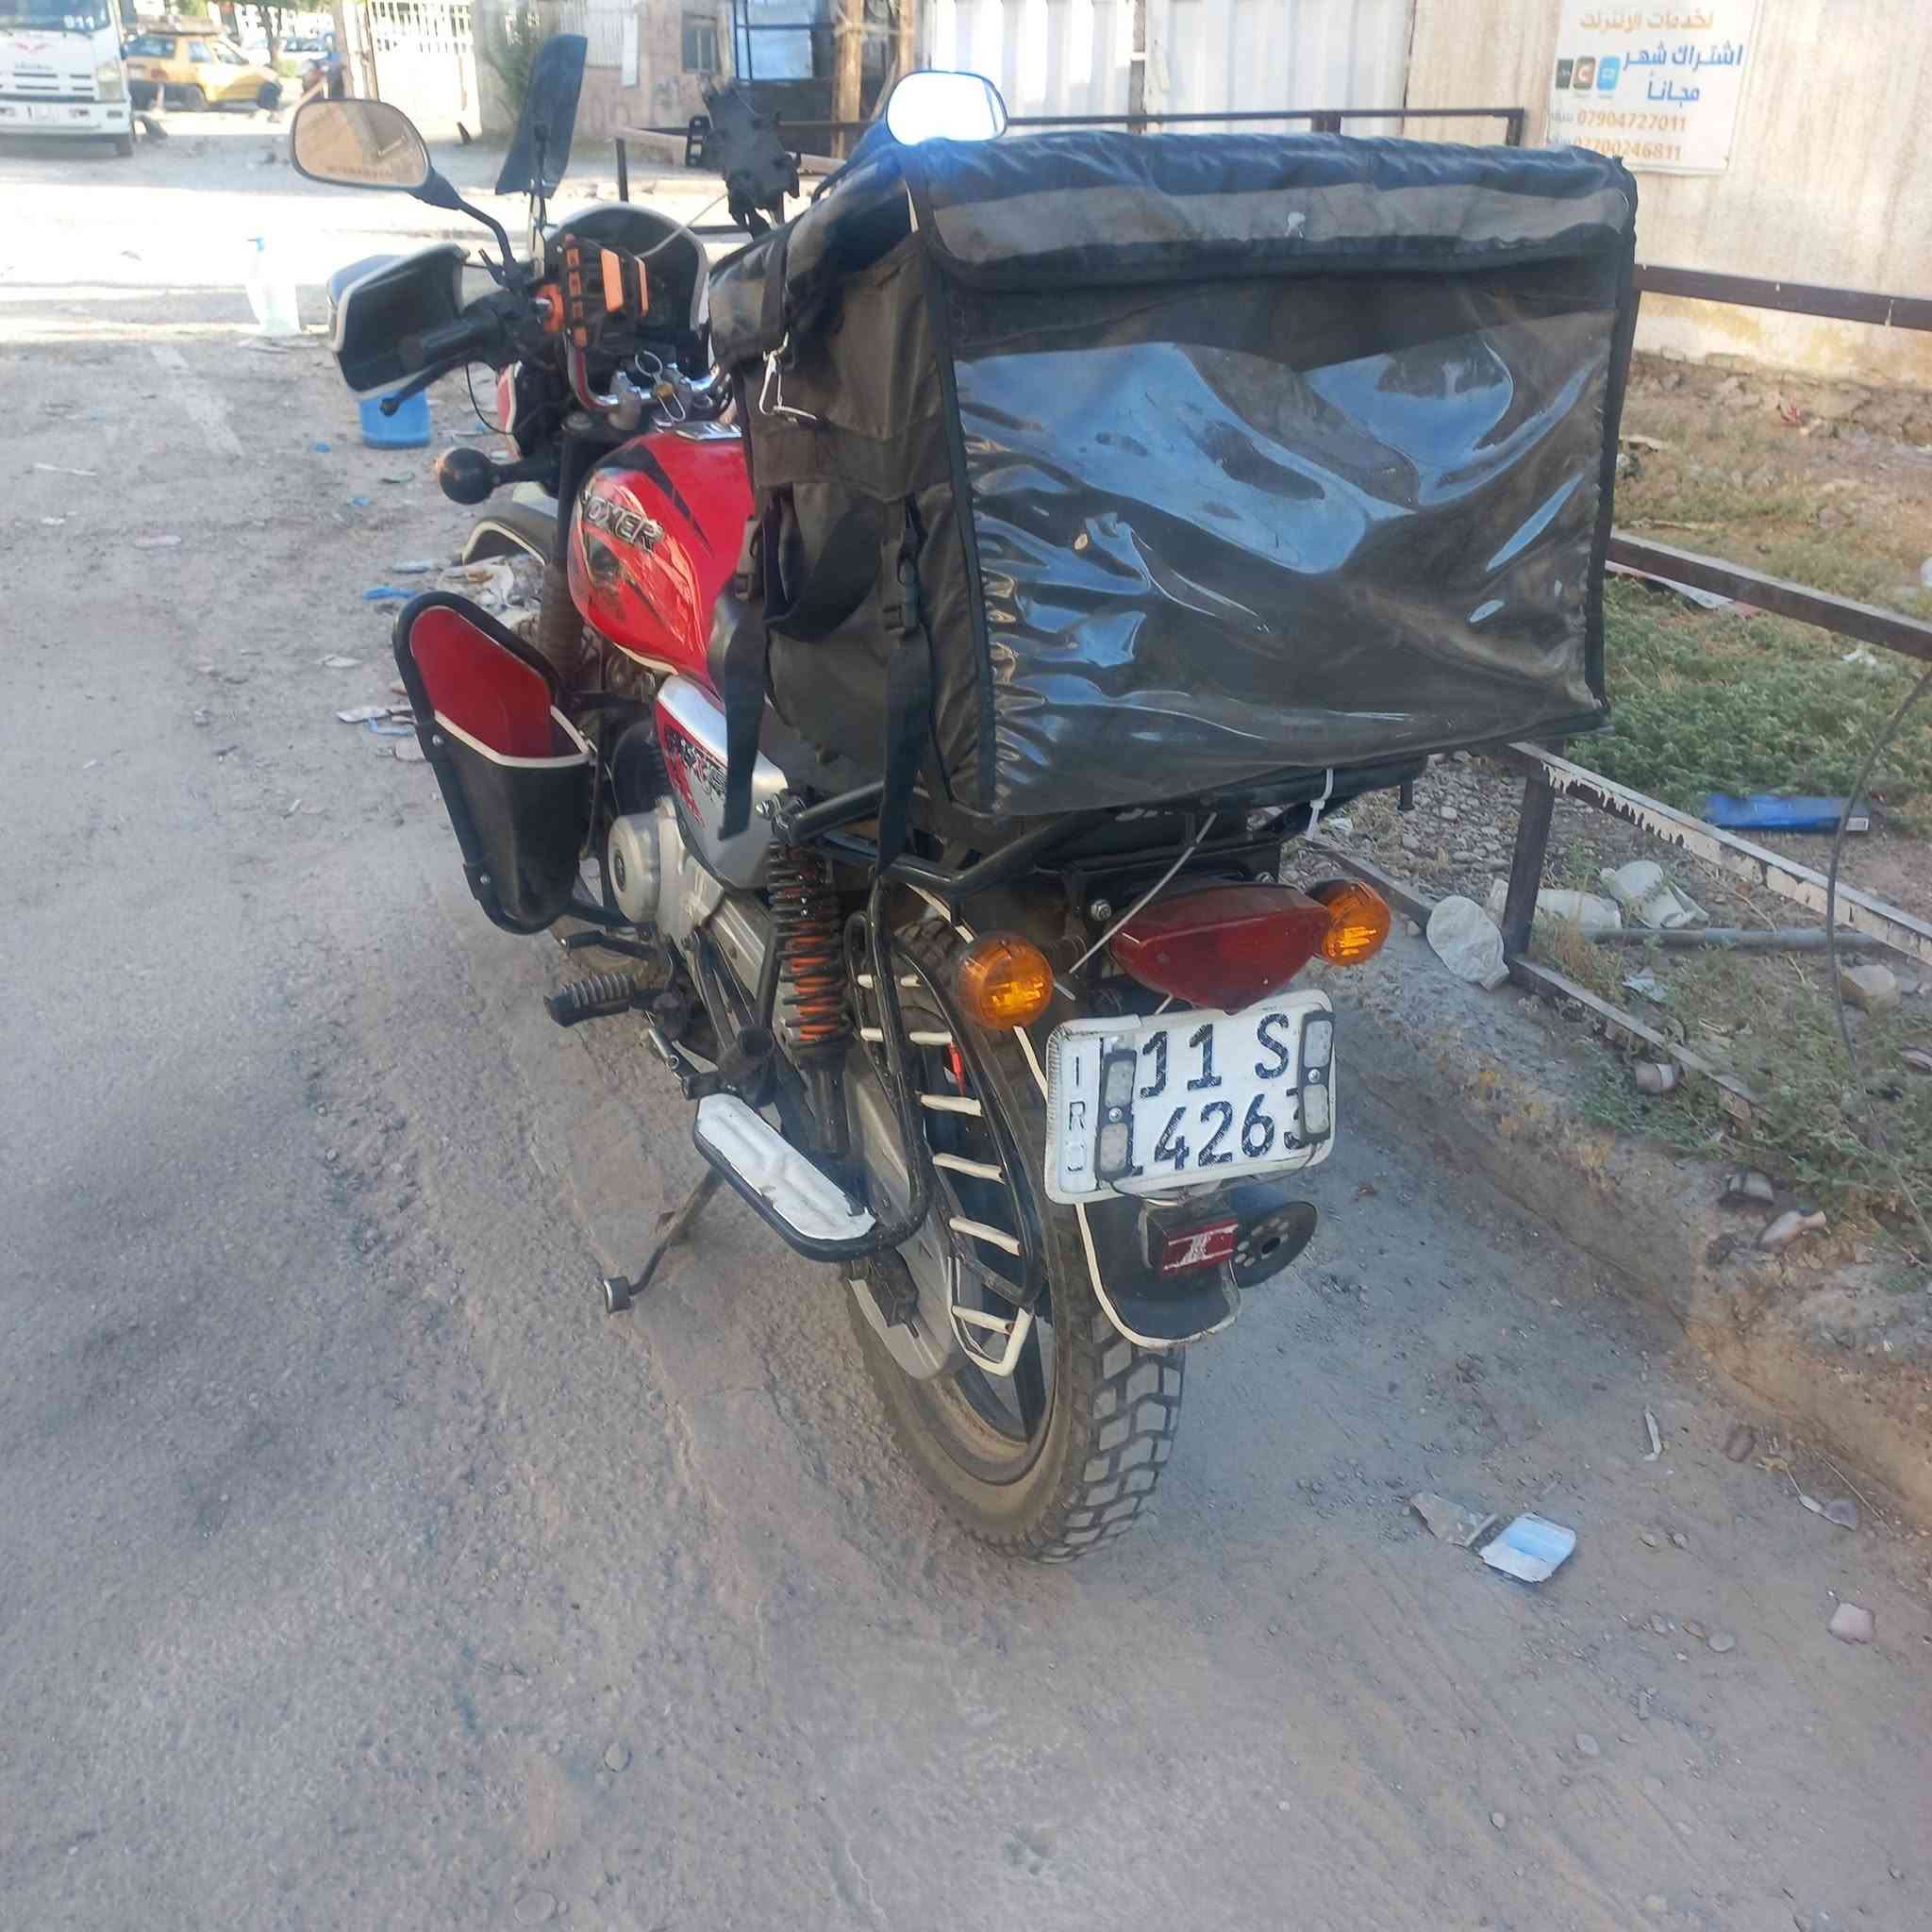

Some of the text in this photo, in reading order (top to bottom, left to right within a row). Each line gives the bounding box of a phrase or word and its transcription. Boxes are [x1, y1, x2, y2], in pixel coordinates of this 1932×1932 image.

[1624, 41, 1743, 73] اشتراك شهر
[1577, 108, 1687, 131] 07904727011
[1255, 1013, 1290, 1080] S
